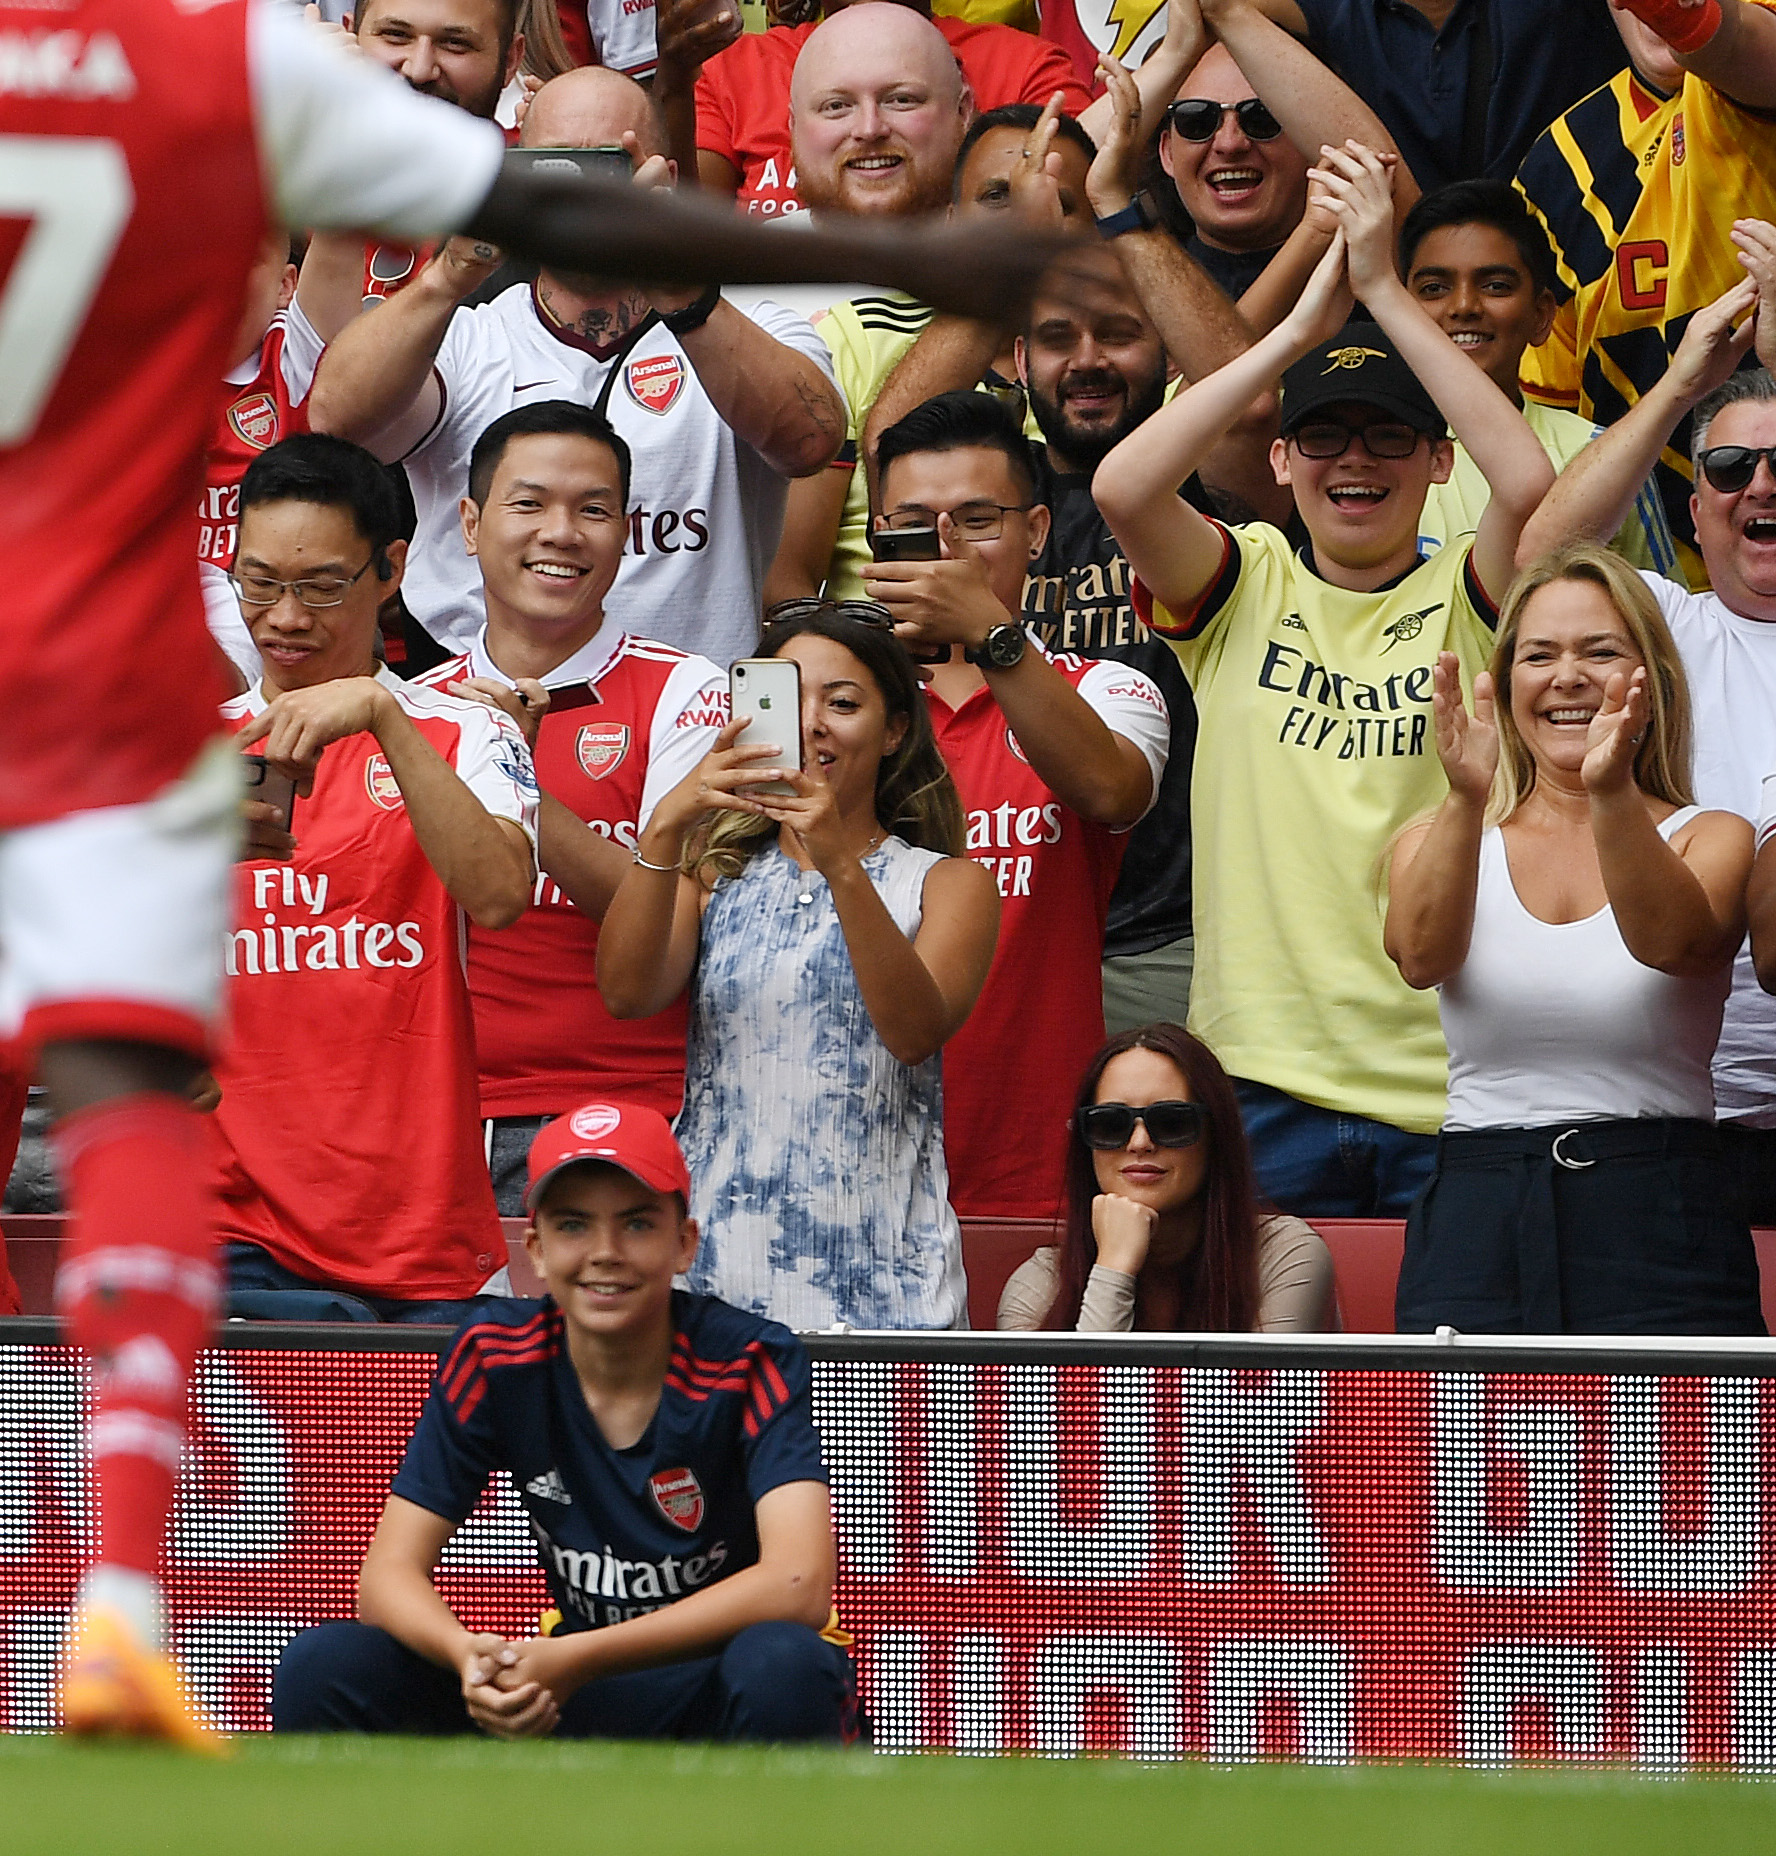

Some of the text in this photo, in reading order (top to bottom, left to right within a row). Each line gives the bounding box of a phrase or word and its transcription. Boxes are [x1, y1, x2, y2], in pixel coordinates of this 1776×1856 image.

[631, 358, 678, 377] Arsenal
[237, 402, 270, 421] Arsenal
[583, 729, 623, 744] Arsenal
[1279, 706, 1339, 751] FLY
[965, 799, 1062, 851] ates
[254, 865, 328, 915] Fly
[655, 1474, 696, 1494] Arsenal
[551, 1540, 729, 1601] mirates
